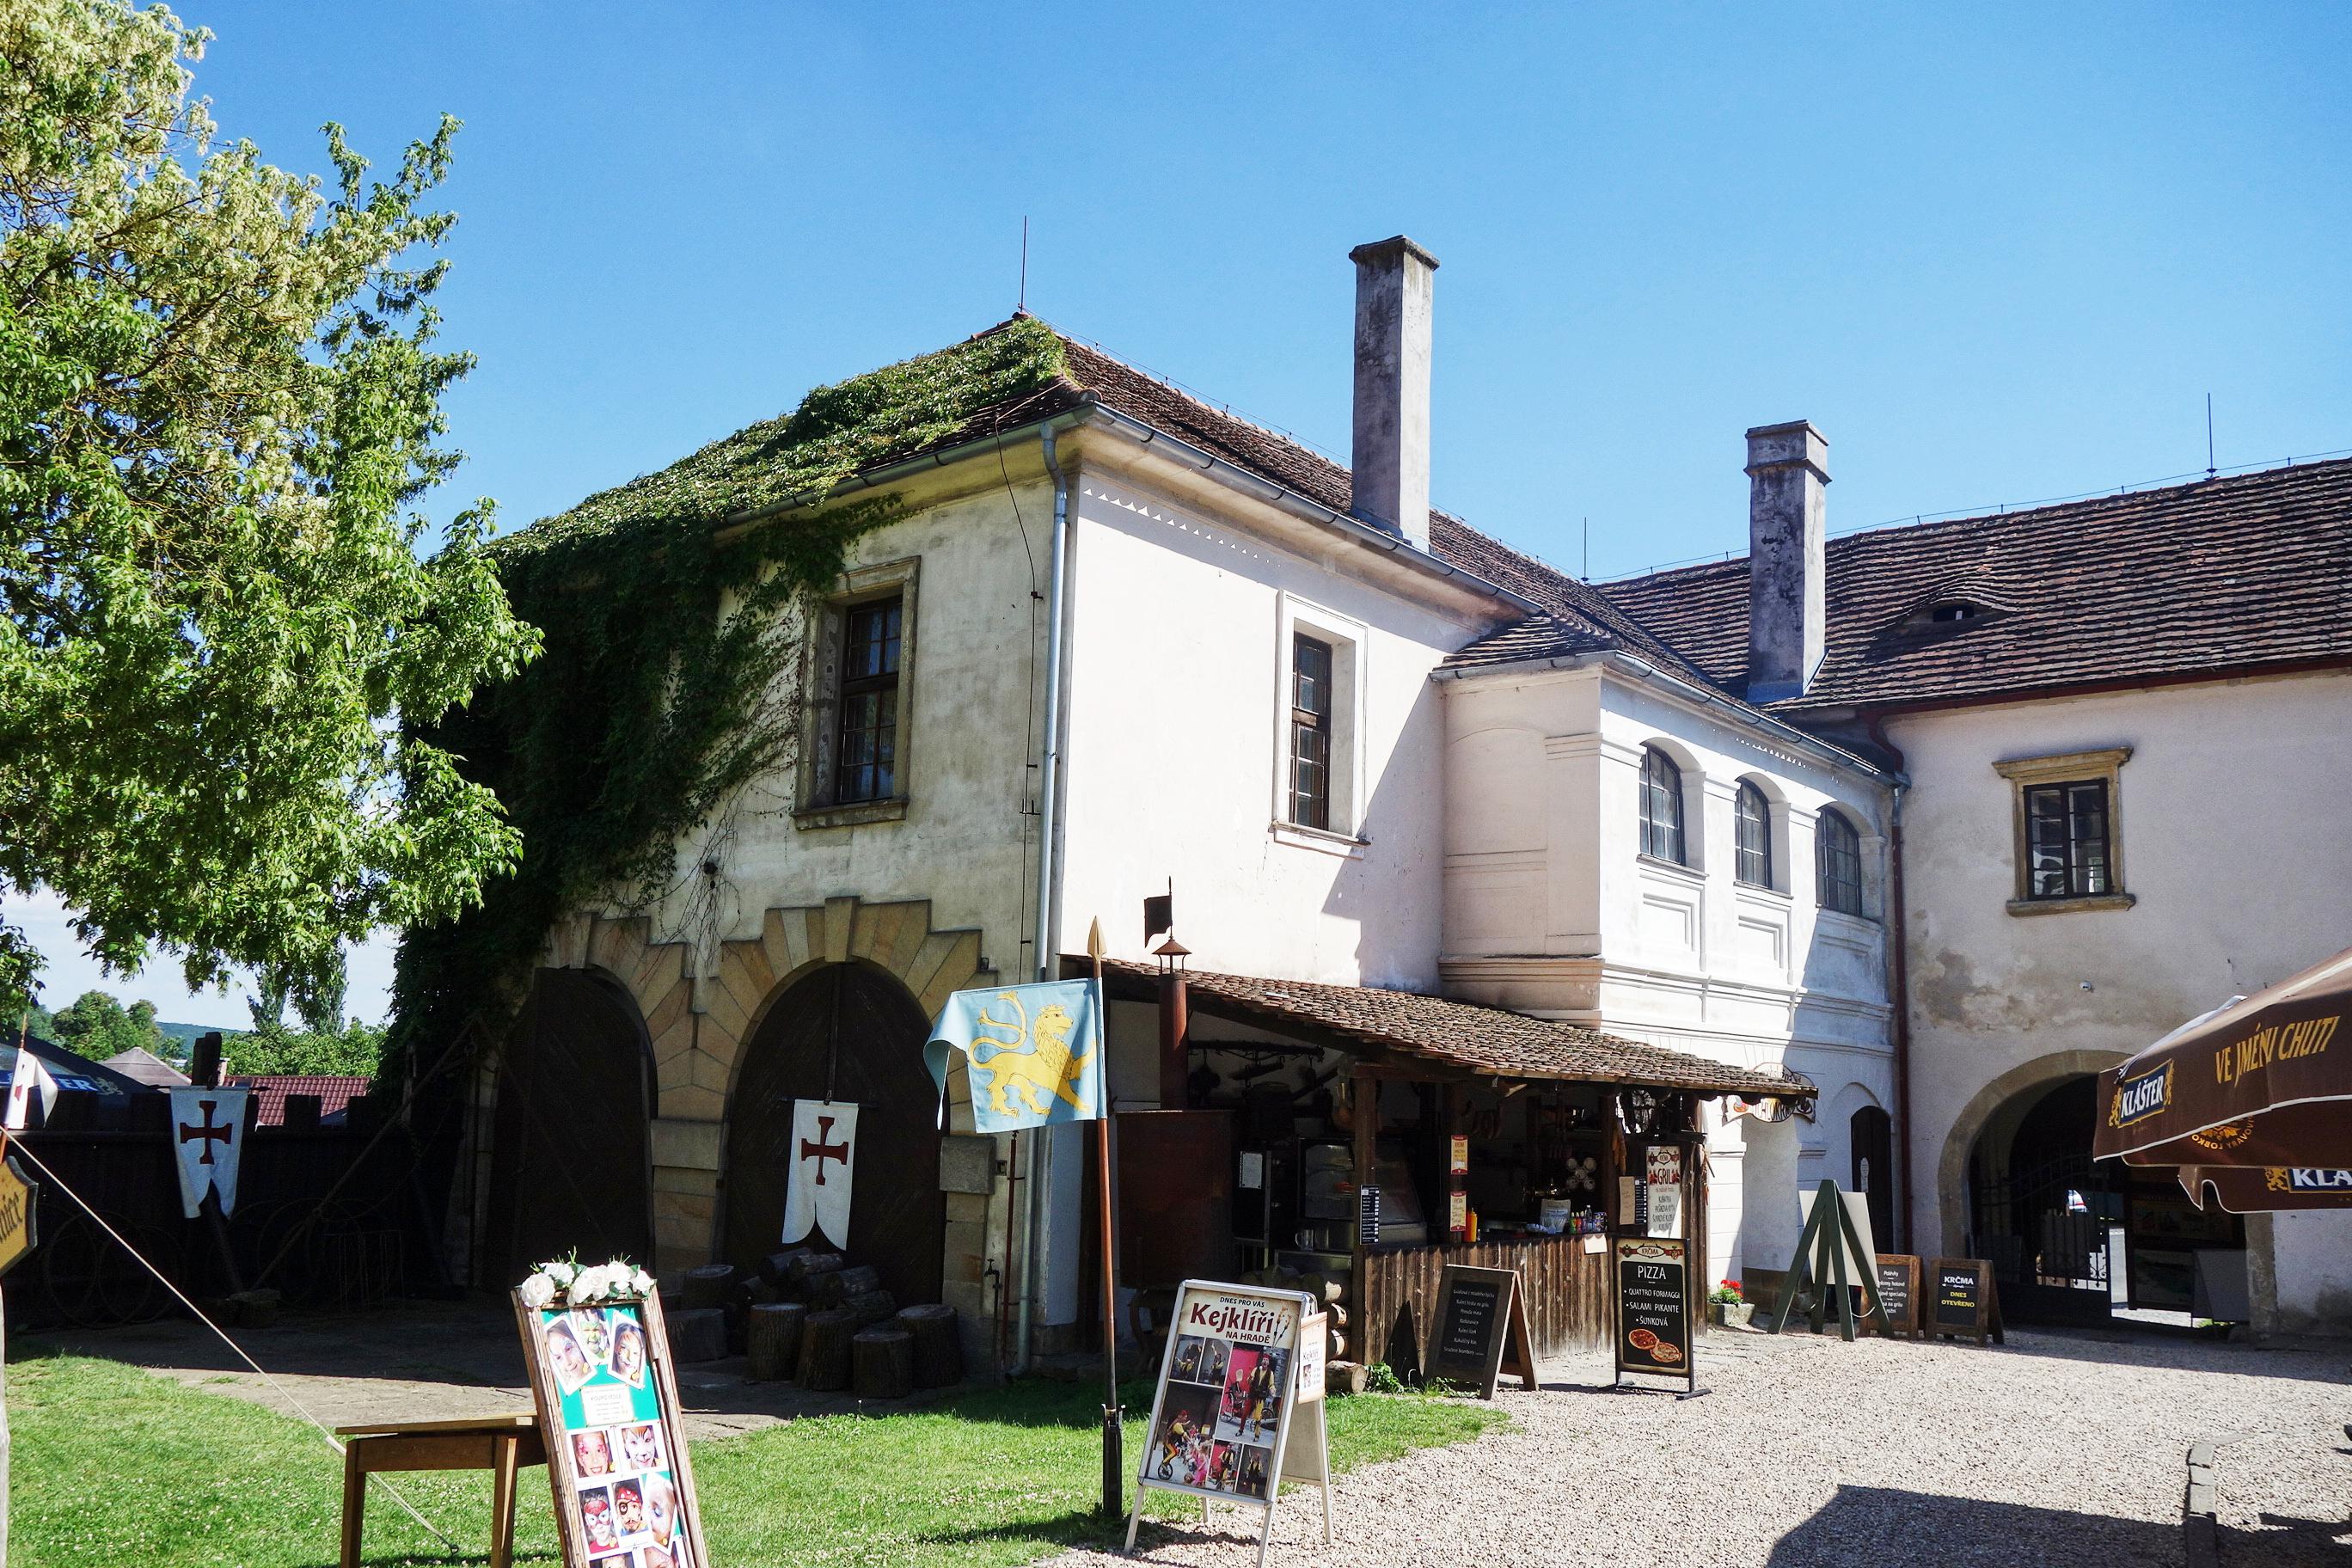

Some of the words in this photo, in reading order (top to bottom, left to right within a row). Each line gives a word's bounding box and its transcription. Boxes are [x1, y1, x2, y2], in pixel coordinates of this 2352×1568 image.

[2215, 1046, 2233, 1085] VE
[2234, 1022, 2278, 1087] JMÉNU
[2278, 1015, 2341, 1061] CHUTI
[2121, 1075, 2165, 1118] KLÁŠTER
[2191, 1134, 2224, 1150] LOBKO
[1657, 1168, 1672, 1185] GRIL
[1638, 1265, 1666, 1280] PIZZA
[1944, 1276, 1974, 1284] KRČMA
[1628, 1288, 1652, 1296] QUATTRO
[1653, 1289, 1681, 1299] FORMAGGI
[1629, 1302, 1652, 1310] SALAMI
[1654, 1303, 1679, 1314] PIKANTE
[1941, 1299, 1975, 1308] OTEVŘENO
[1190, 1302, 1275, 1333] Kejklíři
[1639, 1315, 1668, 1326] ŠUNKOVÁ
[1225, 1331, 1238, 1339] NA
[1240, 1333, 1271, 1344] HRADĚ
